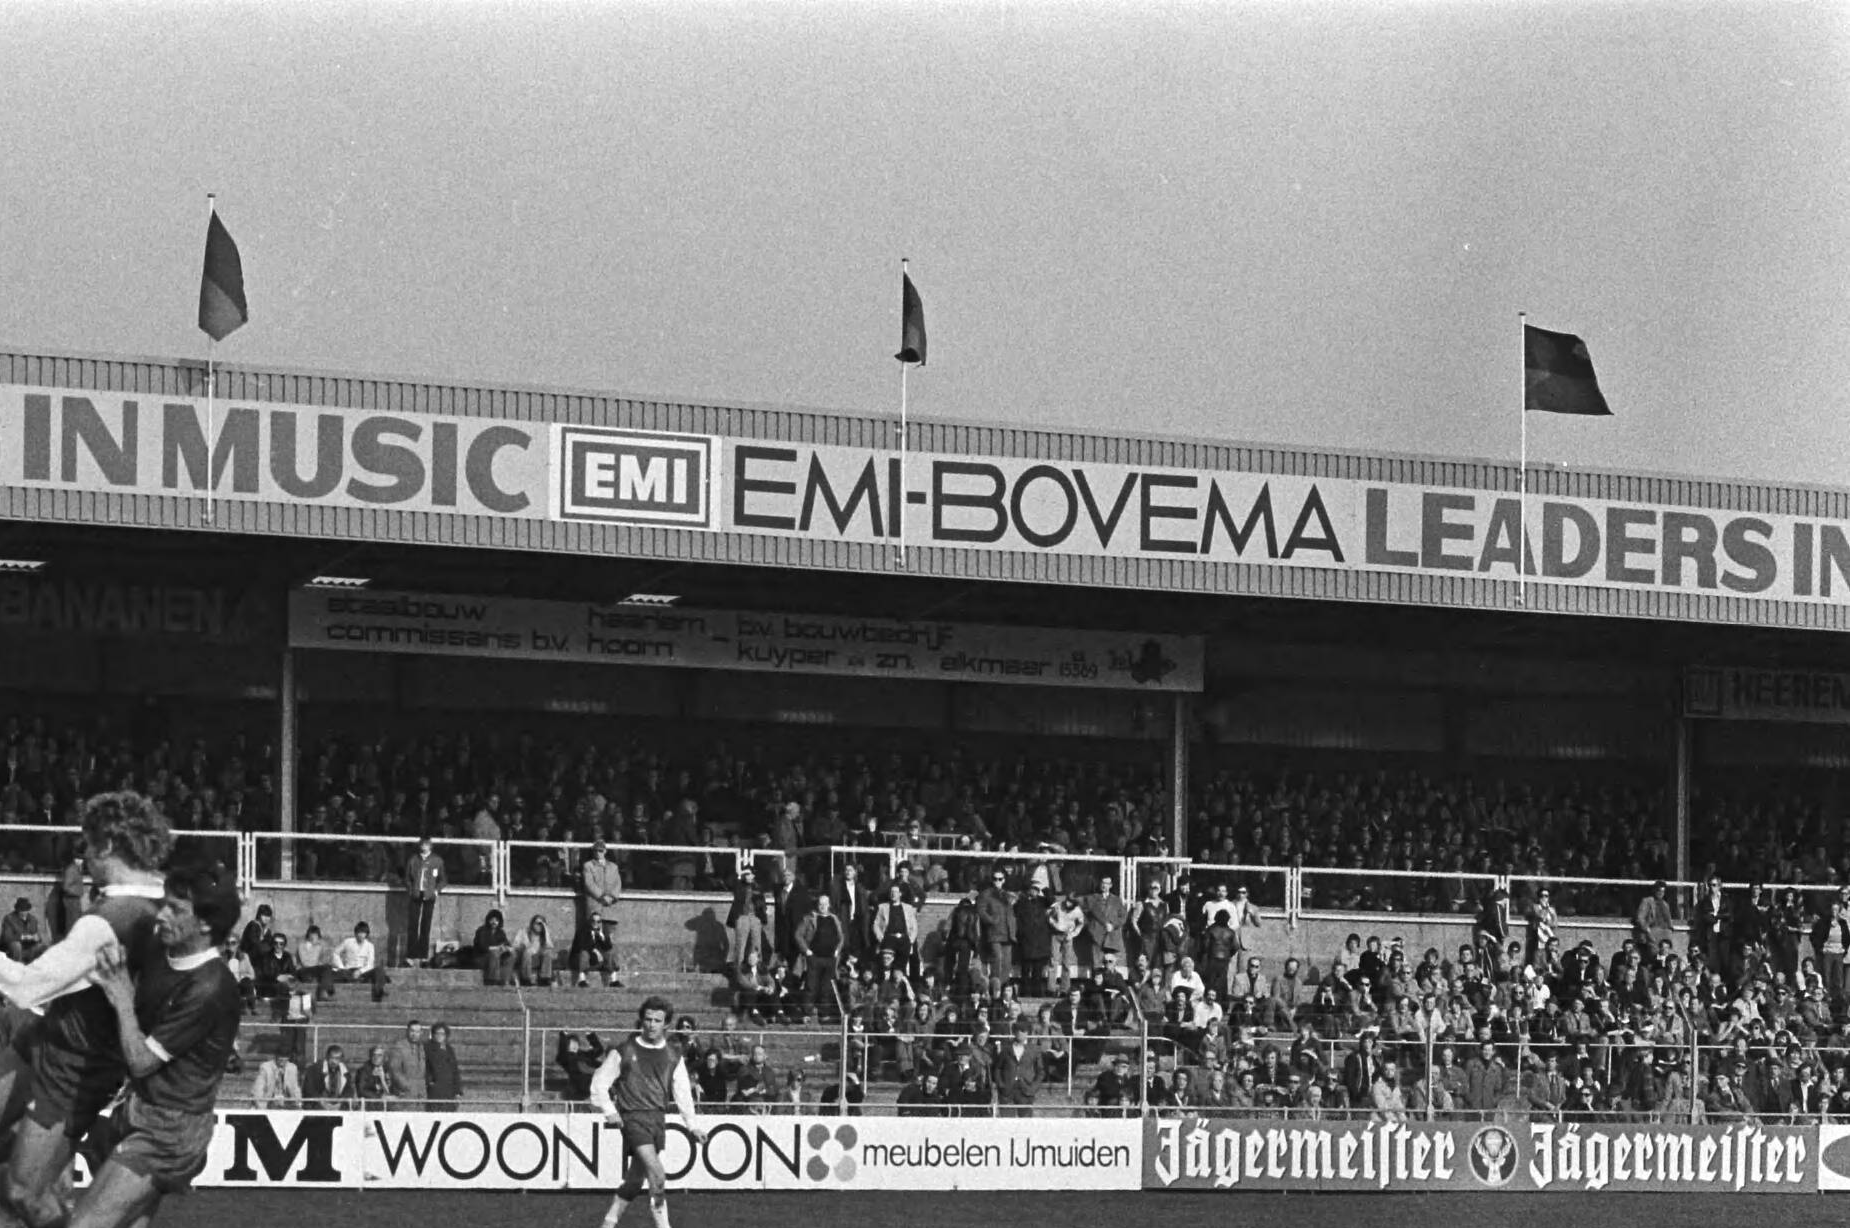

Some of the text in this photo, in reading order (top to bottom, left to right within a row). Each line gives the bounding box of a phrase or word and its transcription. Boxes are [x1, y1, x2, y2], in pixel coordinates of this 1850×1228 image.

[23, 394, 138, 487] IN
[162, 402, 532, 513] MUSIC
[584, 451, 688, 504] EMI
[733, 444, 1346, 563] EMI-BOVEMA
[1365, 487, 1778, 593] LEADERS
[587, 606, 706, 634] haarlem
[586, 632, 674, 657] hoorn
[736, 641, 837, 668] kuyper
[940, 652, 1051, 678] alkmaar
[863, 1136, 1130, 1168] meubelen IJmuiden
